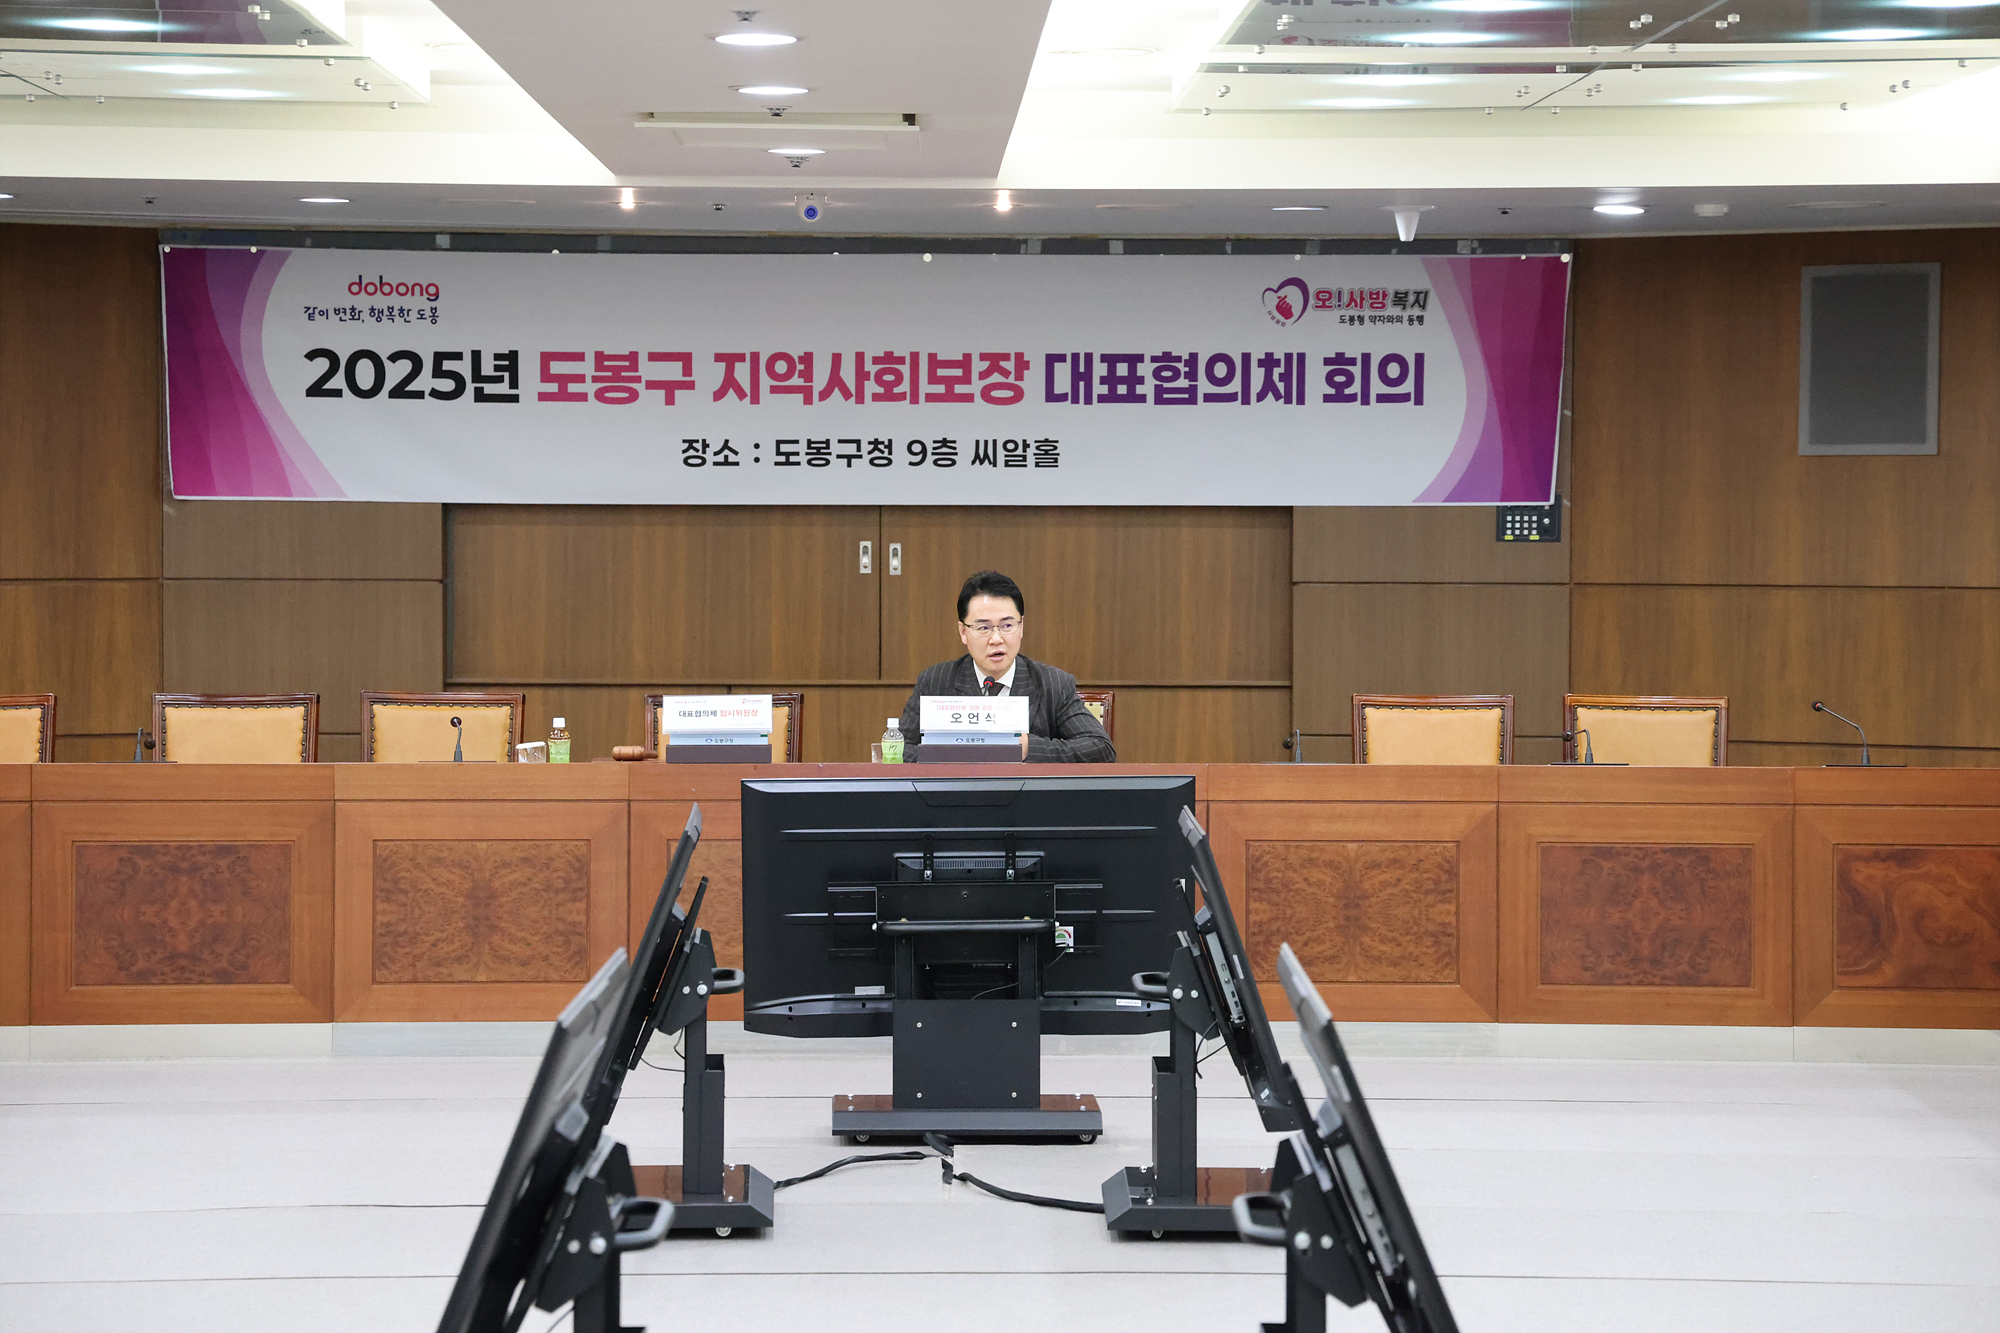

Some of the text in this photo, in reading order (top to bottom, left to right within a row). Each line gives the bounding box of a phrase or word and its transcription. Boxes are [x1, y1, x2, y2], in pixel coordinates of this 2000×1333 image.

[348, 274, 440, 303] dobong
[303, 305, 439, 325] 같이 변화, 행복한 도봉
[1339, 314, 1425, 326] 도봉형 약자와의 동행
[304, 348, 1425, 406] 2025년 도봉구 지역사회보장 대표협의체 회의
[681, 438, 741, 468] 장소
[774, 438, 894, 469] 도봉구청
[906, 437, 959, 468] 9층
[970, 437, 1061, 469] 씨알홀
[720, 709, 759, 717] 임시위원장
